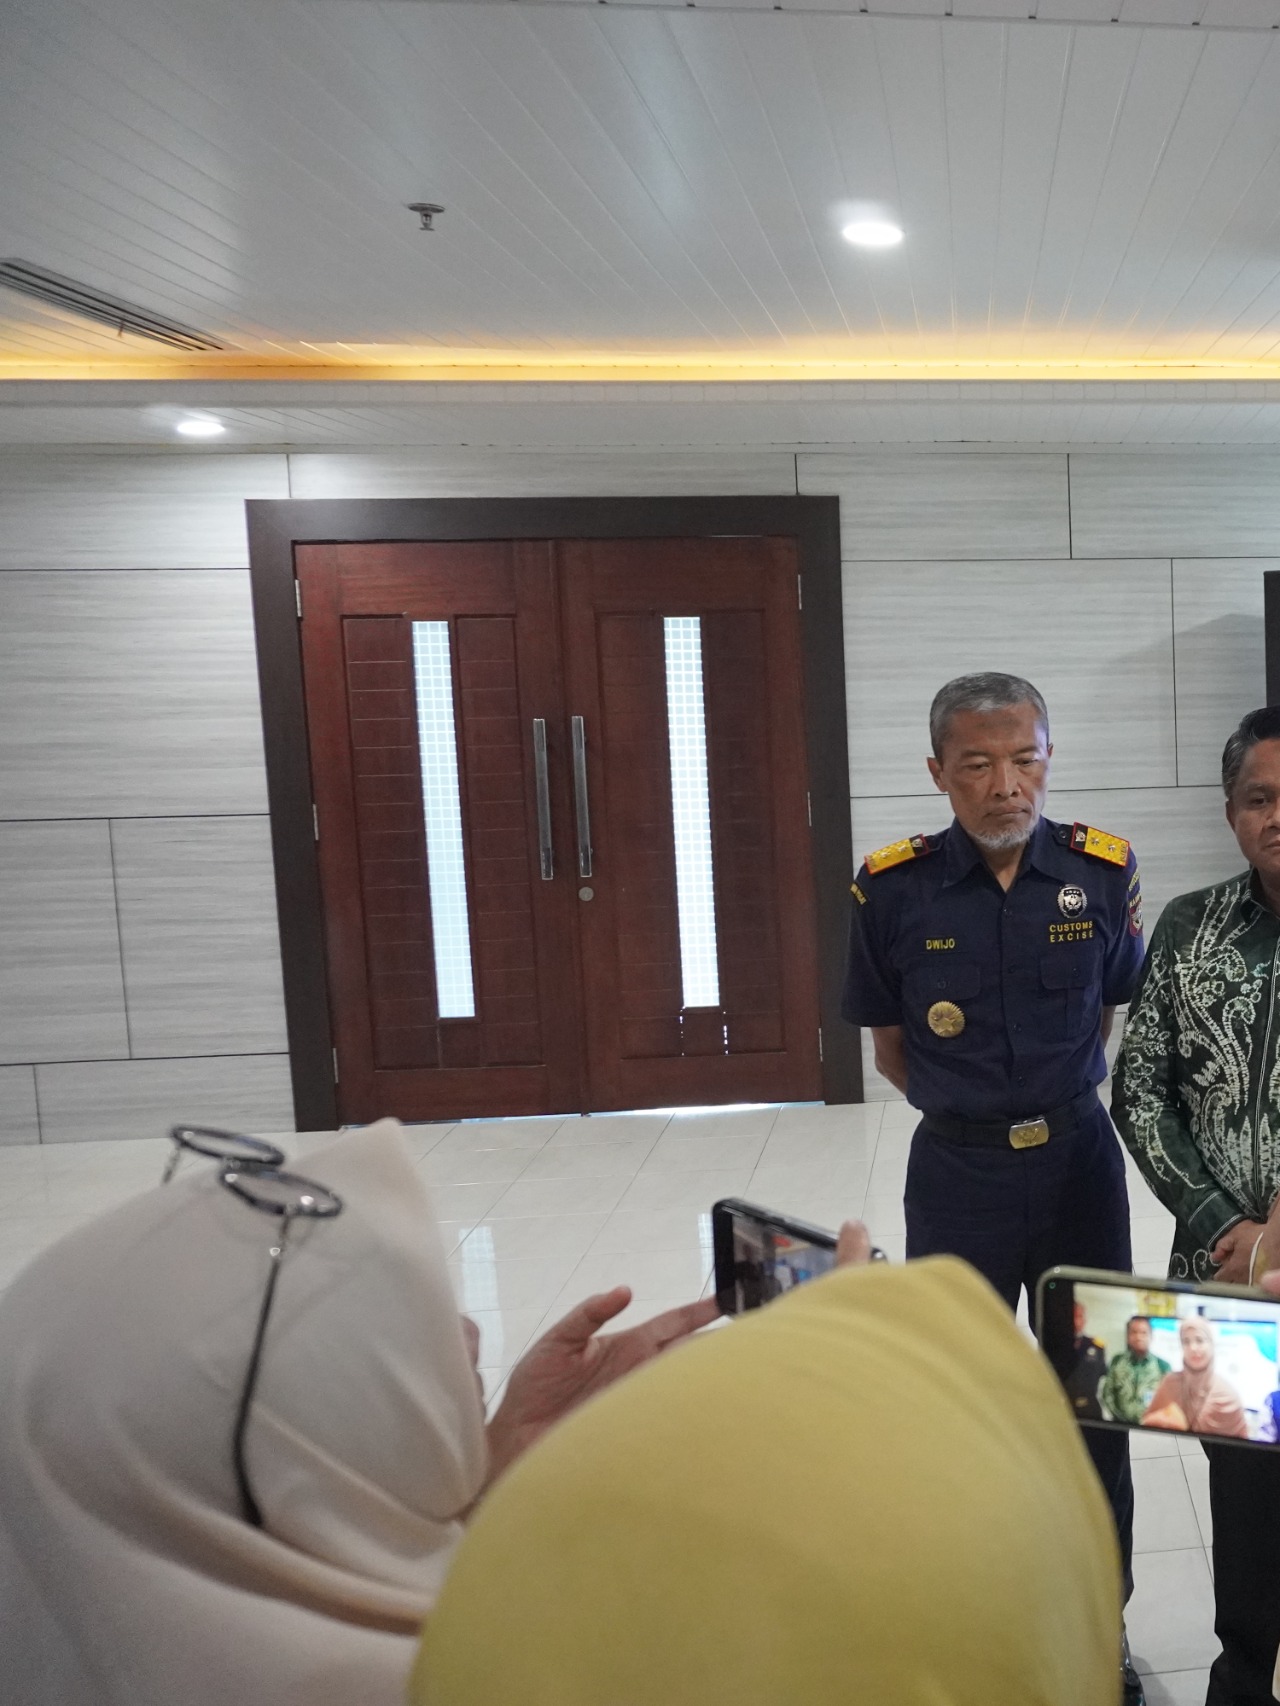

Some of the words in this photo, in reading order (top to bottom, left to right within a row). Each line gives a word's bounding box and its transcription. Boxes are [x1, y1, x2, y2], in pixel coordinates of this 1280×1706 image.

[1049, 920, 1093, 932] CUSTOMS
[1049, 930, 1093, 943] EXCISE
[926, 938, 955, 950] DWIJO
